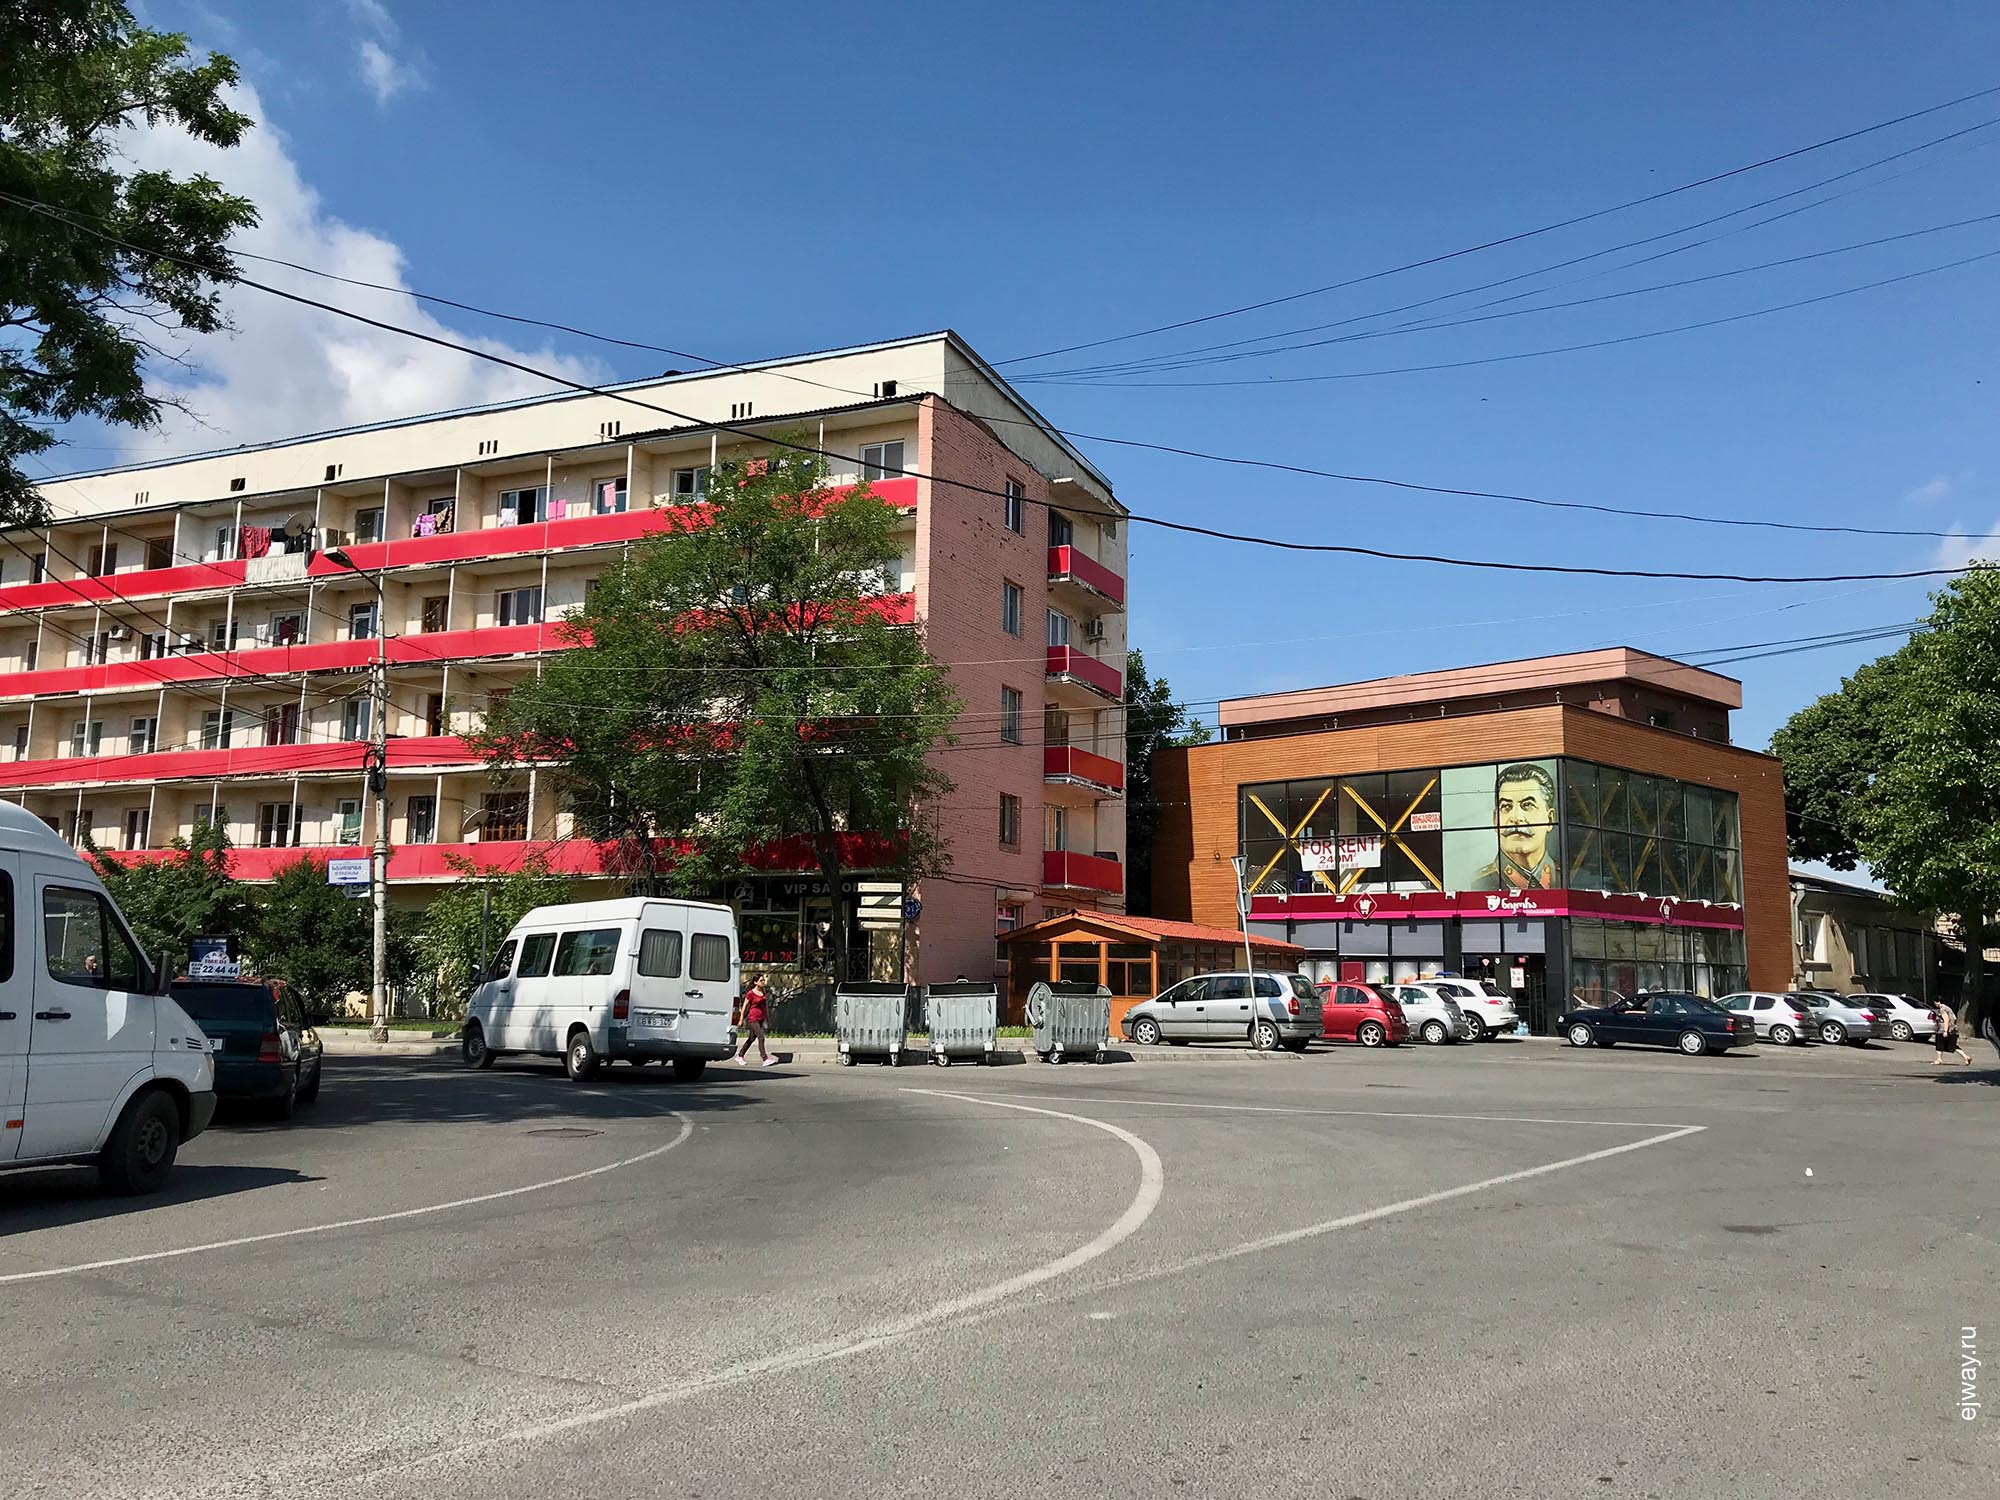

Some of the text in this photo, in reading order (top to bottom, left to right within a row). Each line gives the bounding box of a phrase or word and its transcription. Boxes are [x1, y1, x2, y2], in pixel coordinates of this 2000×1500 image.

[1301, 836, 1379, 856] FOR RENT
[784, 883, 808, 894] VIP
[202, 965, 214, 974] 22
[215, 966, 226, 974] 44
[228, 967, 239, 975] 44
